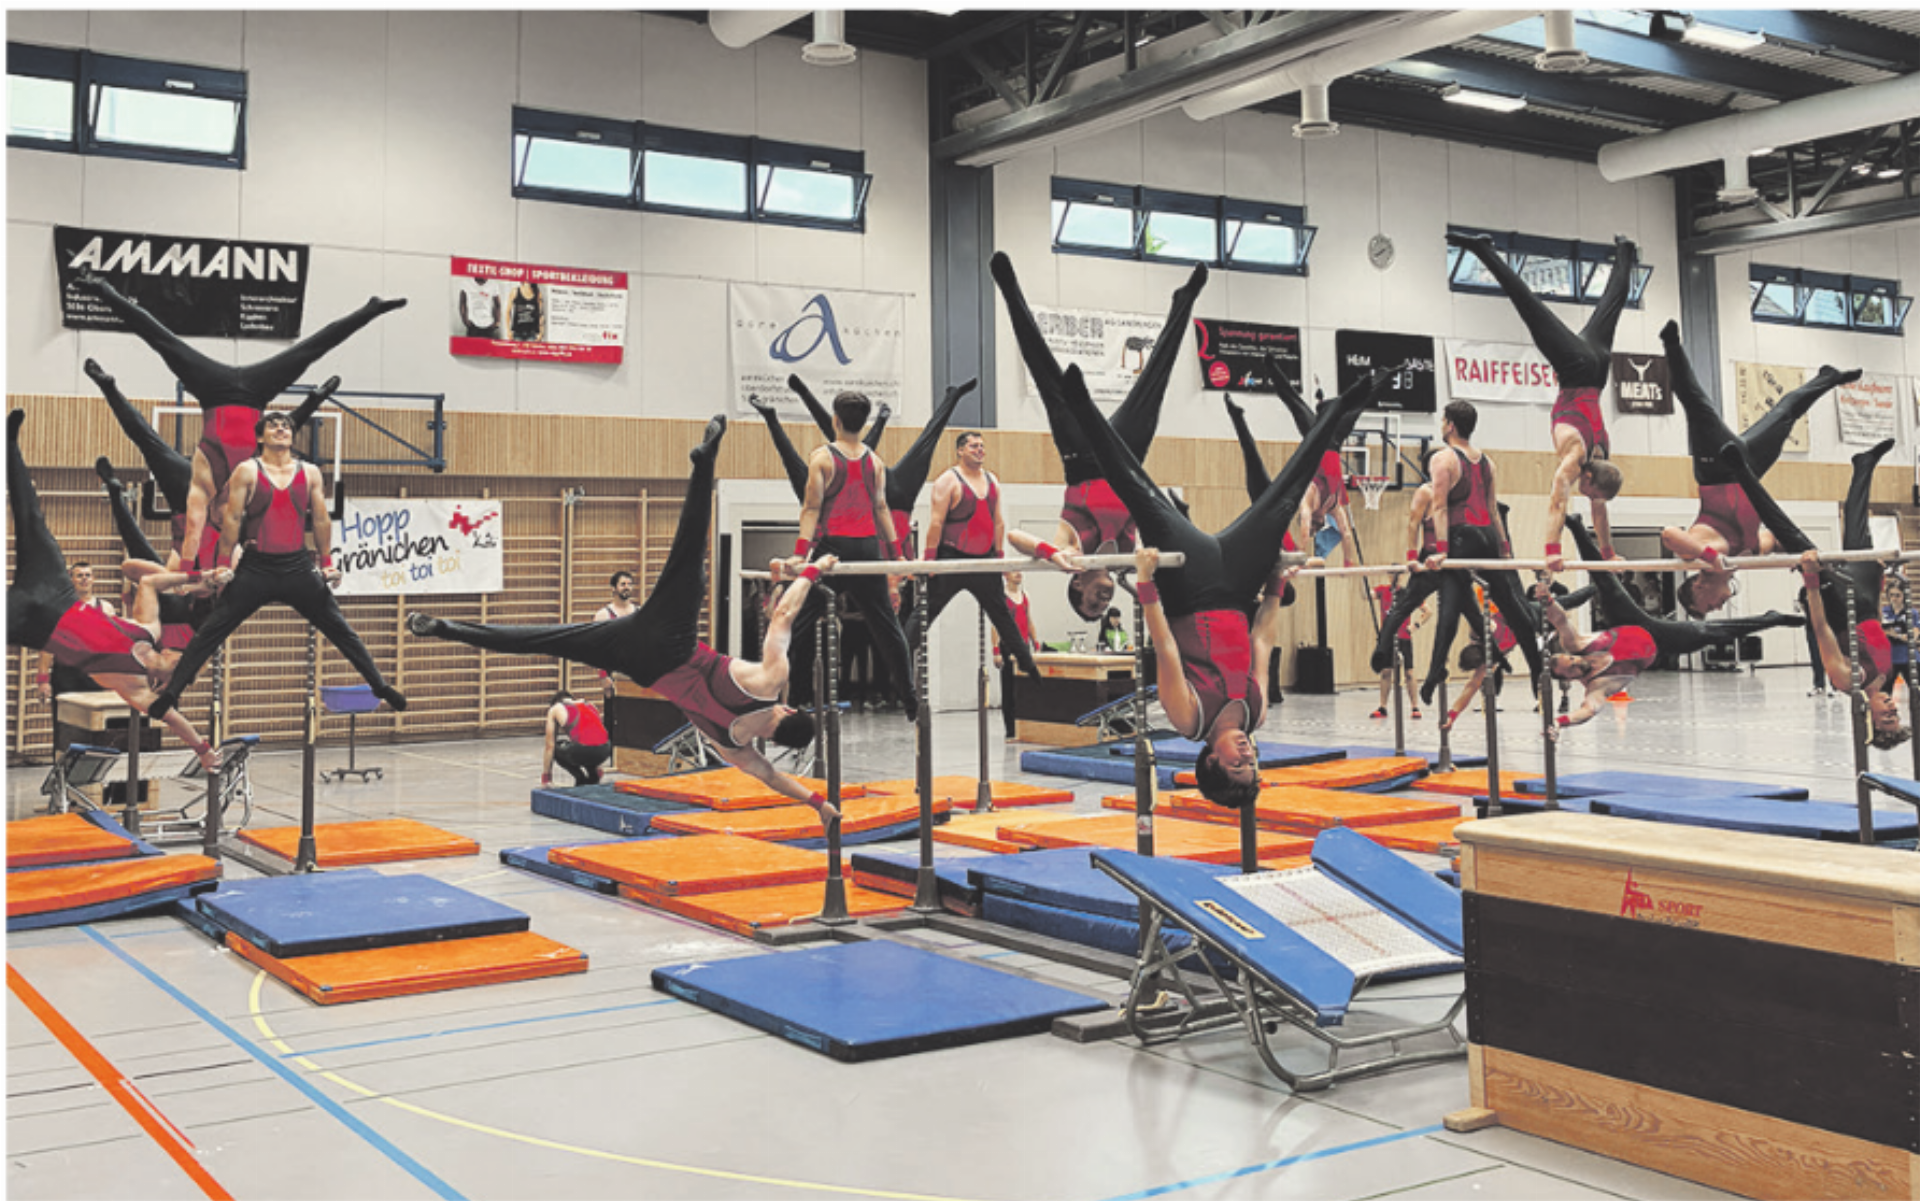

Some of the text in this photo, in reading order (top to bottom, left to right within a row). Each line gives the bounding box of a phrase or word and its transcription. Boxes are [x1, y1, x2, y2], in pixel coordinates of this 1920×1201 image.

[68, 236, 299, 282] AMMANN
[1346, 354, 1371, 366] HEIM
[340, 508, 411, 545] Hopp
[381, 549, 461, 589] toi toi toi
